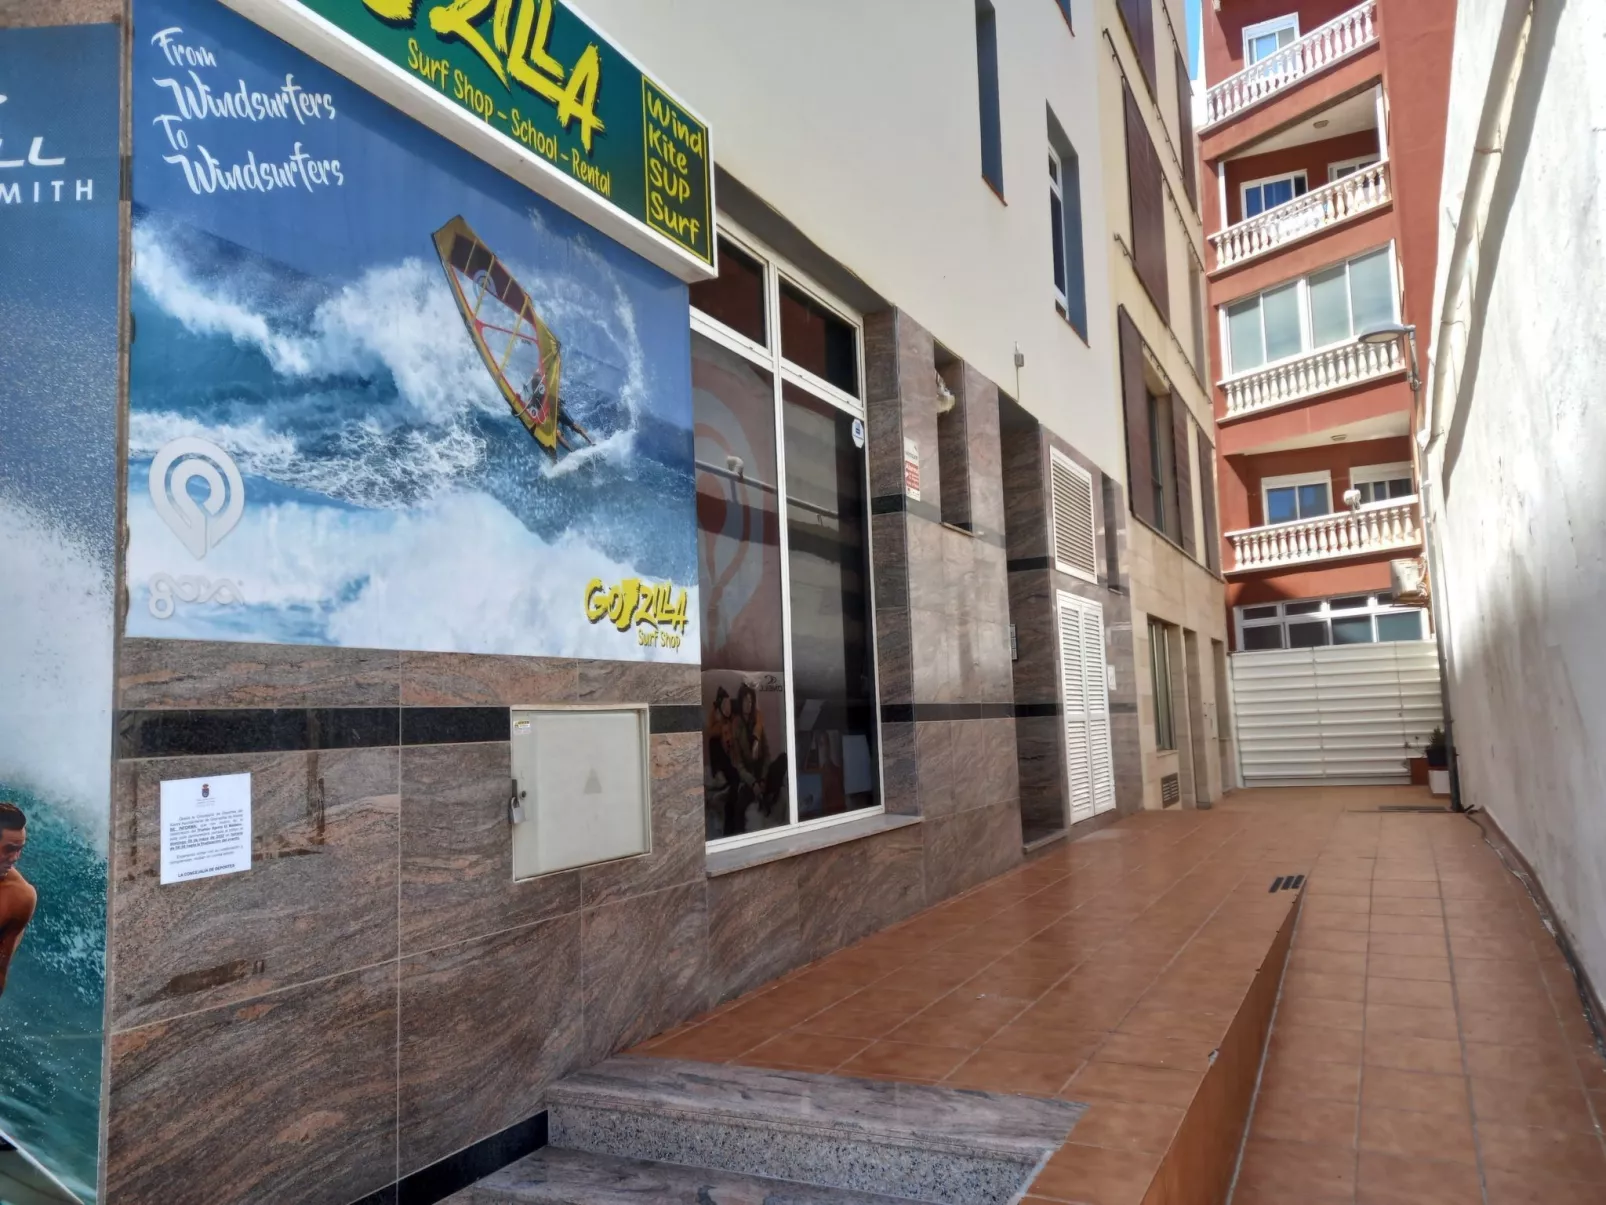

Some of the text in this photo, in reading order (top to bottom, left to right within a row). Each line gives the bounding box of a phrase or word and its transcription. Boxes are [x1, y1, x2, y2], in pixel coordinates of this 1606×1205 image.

[151, 27, 217, 68] From
[152, 70, 336, 125] Windsurfers
[362, 0, 605, 154] ZILLA
[152, 114, 189, 150] To
[407, 37, 449, 89] Surf
[453, 69, 493, 124] Shop
[511, 108, 558, 161] School
[572, 148, 611, 197] Rental
[647, 88, 703, 160] Wind
[164, 142, 344, 195] Windsurfers
[648, 122, 688, 175] Kite
[650, 158, 691, 204] SUP
[650, 191, 700, 245] Surf
[638, 629, 681, 653] Surf Shop
